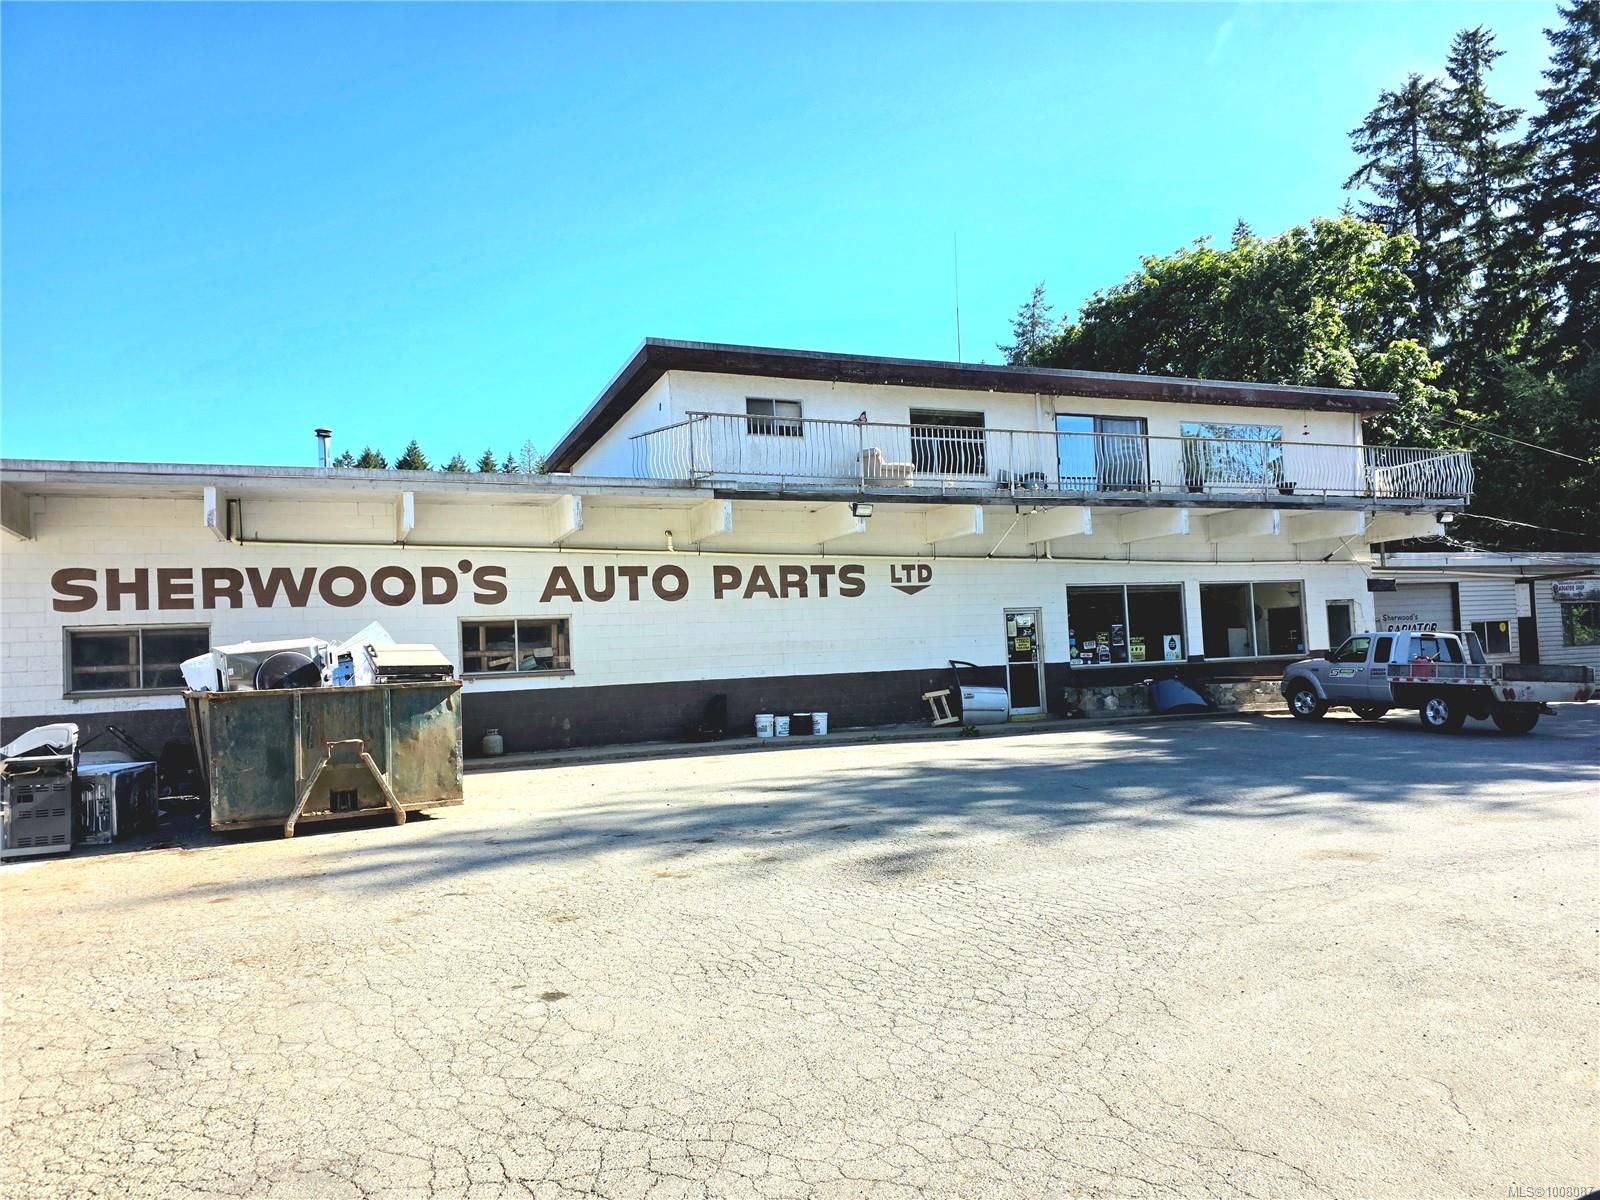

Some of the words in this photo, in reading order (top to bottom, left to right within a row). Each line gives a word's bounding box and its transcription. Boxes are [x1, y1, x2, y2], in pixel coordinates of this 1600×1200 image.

[51, 559, 507, 612] SHERWOOD'S
[540, 564, 689, 603] AUTO
[713, 564, 866, 600] PARTS
[890, 564, 933, 583] LTD
[1382, 613, 1419, 622] Sherwood's
[1388, 622, 1438, 632] RADIATOR
